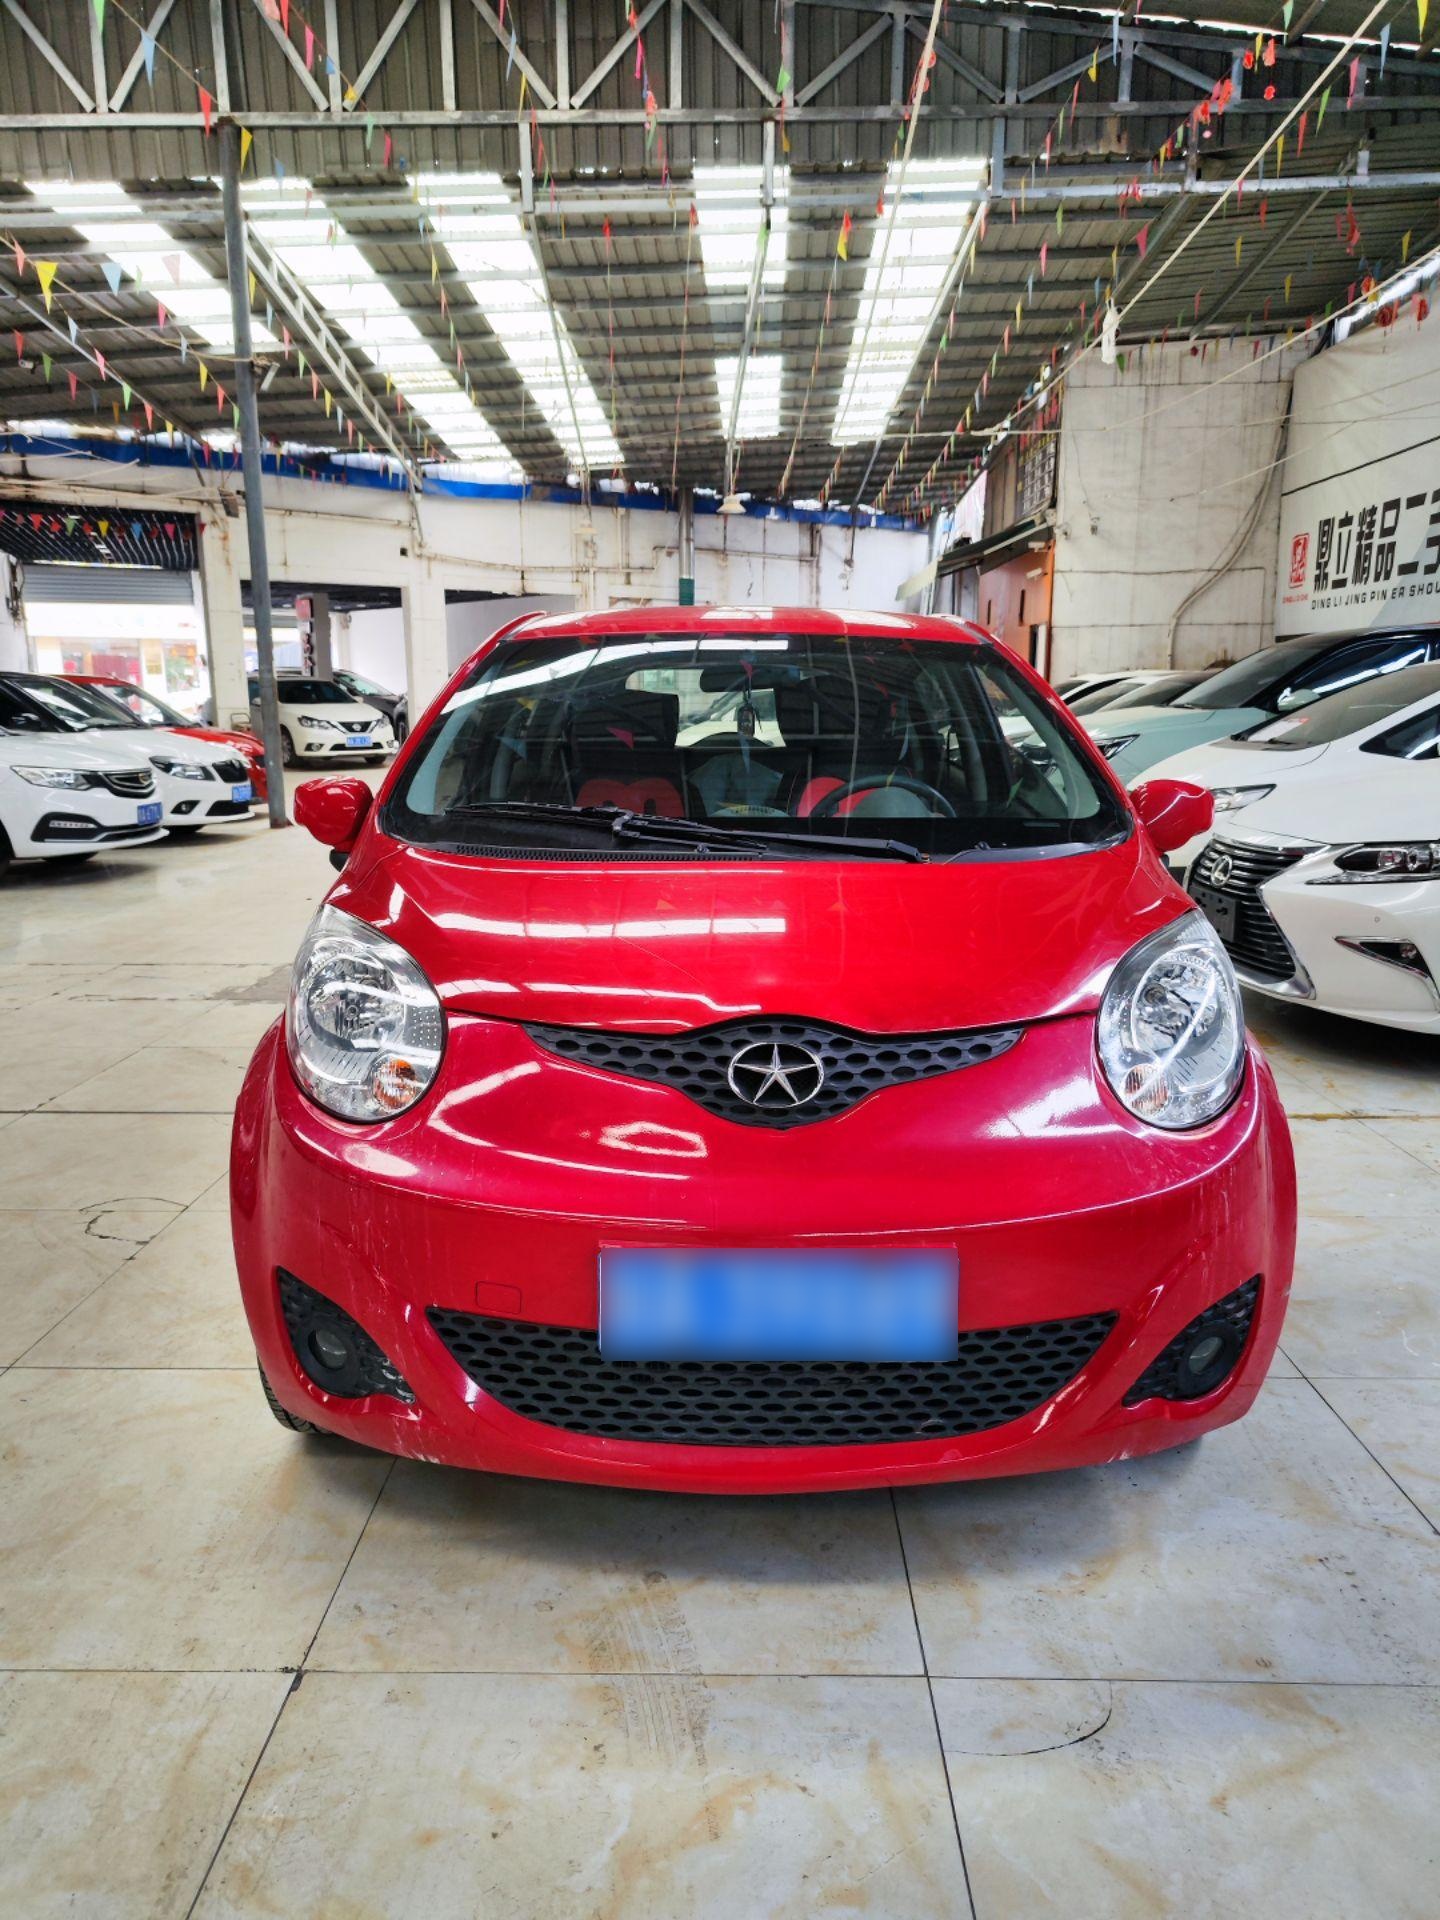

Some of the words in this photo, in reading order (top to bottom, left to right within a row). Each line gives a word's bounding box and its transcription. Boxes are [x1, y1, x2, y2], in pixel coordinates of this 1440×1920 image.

[1311, 597, 1331, 610] DING
[1334, 596, 1342, 607] LI
[1345, 592, 1367, 606] JING
[1370, 590, 1388, 601] PIN
